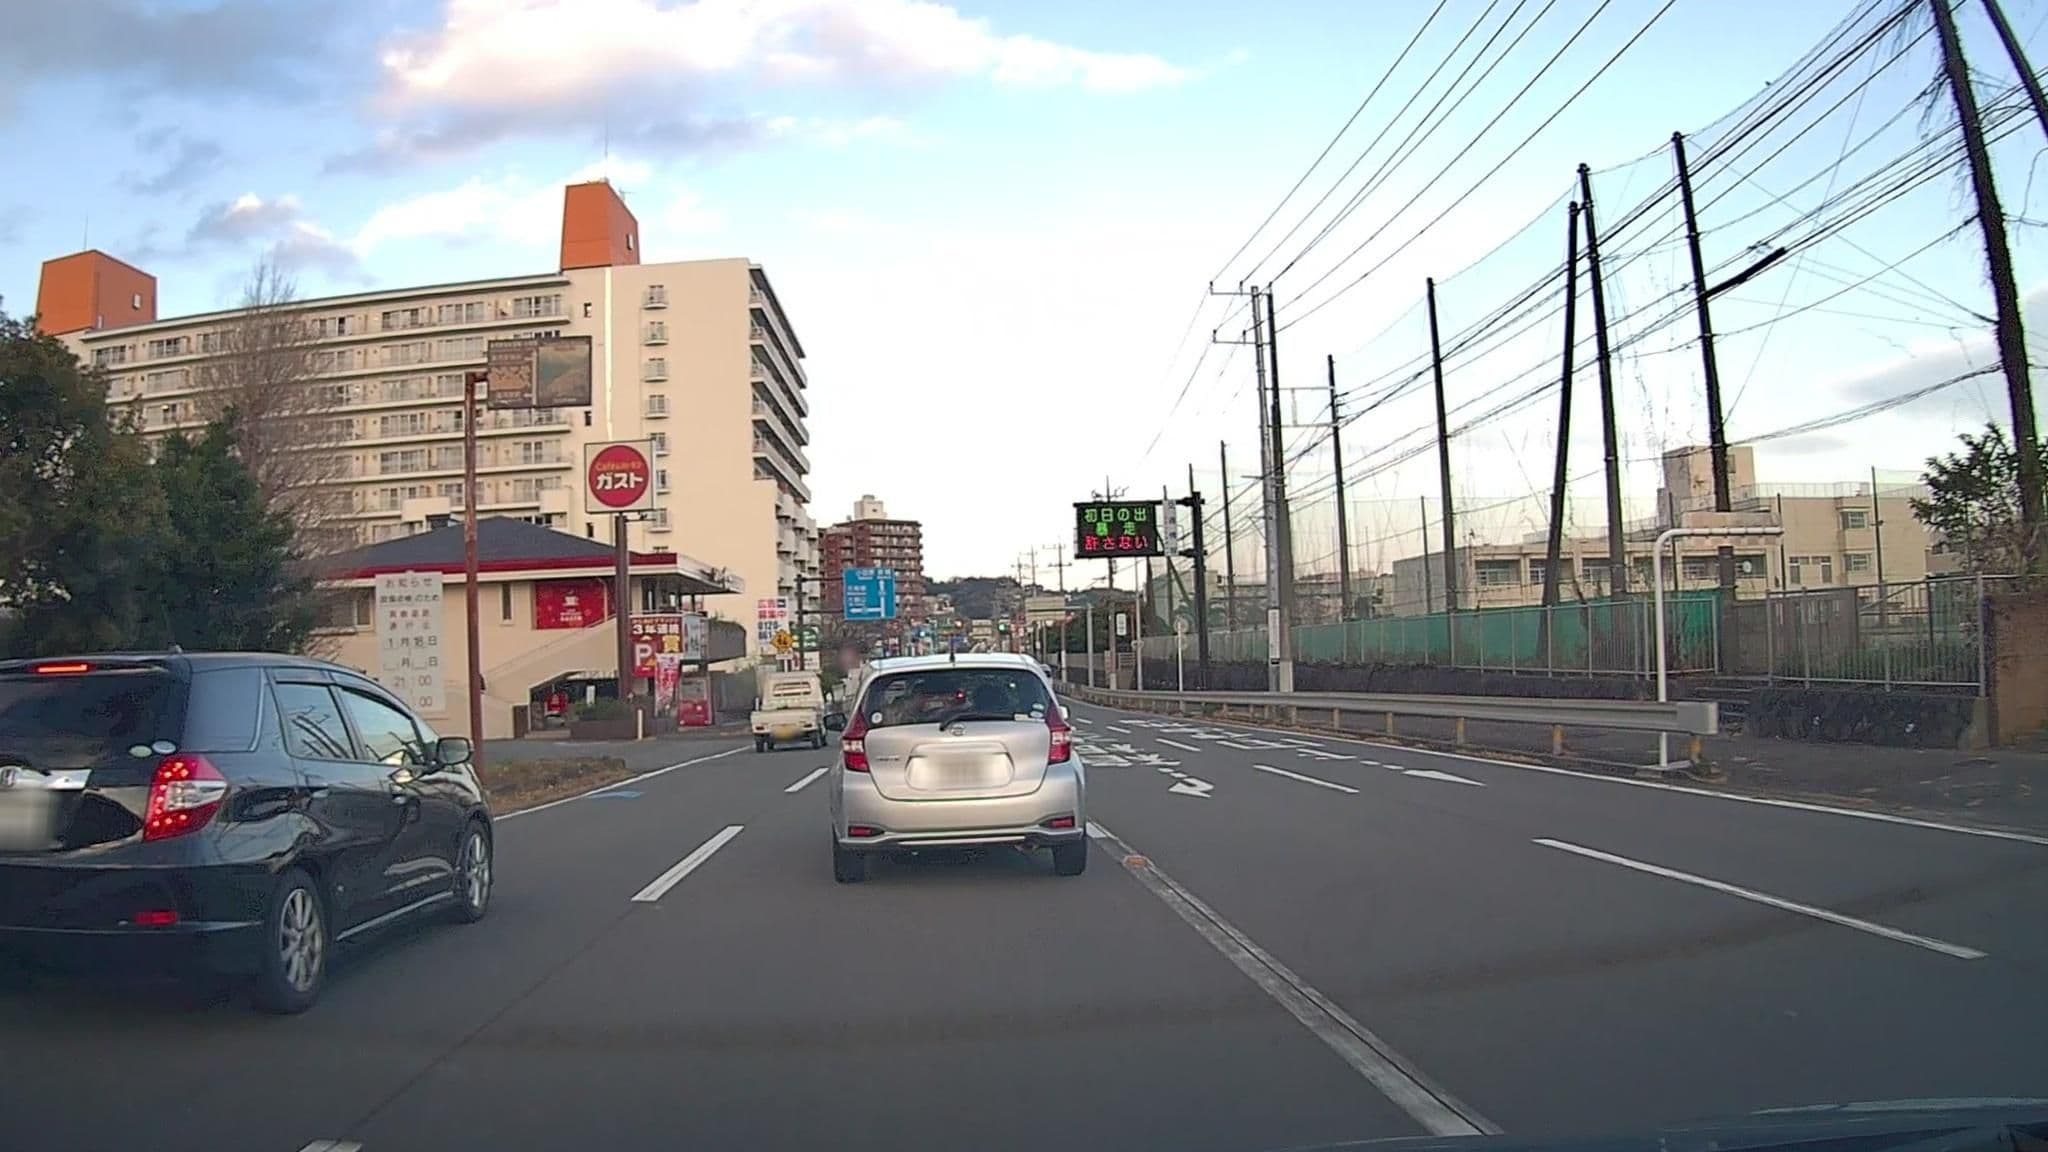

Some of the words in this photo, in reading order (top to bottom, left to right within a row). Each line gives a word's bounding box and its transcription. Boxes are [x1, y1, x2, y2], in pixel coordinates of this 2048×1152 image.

[596, 472, 643, 490] ガスト
[1084, 508, 1147, 522] 初日の出
[1085, 536, 1148, 551] 許さない
[635, 643, 652, 666] P
